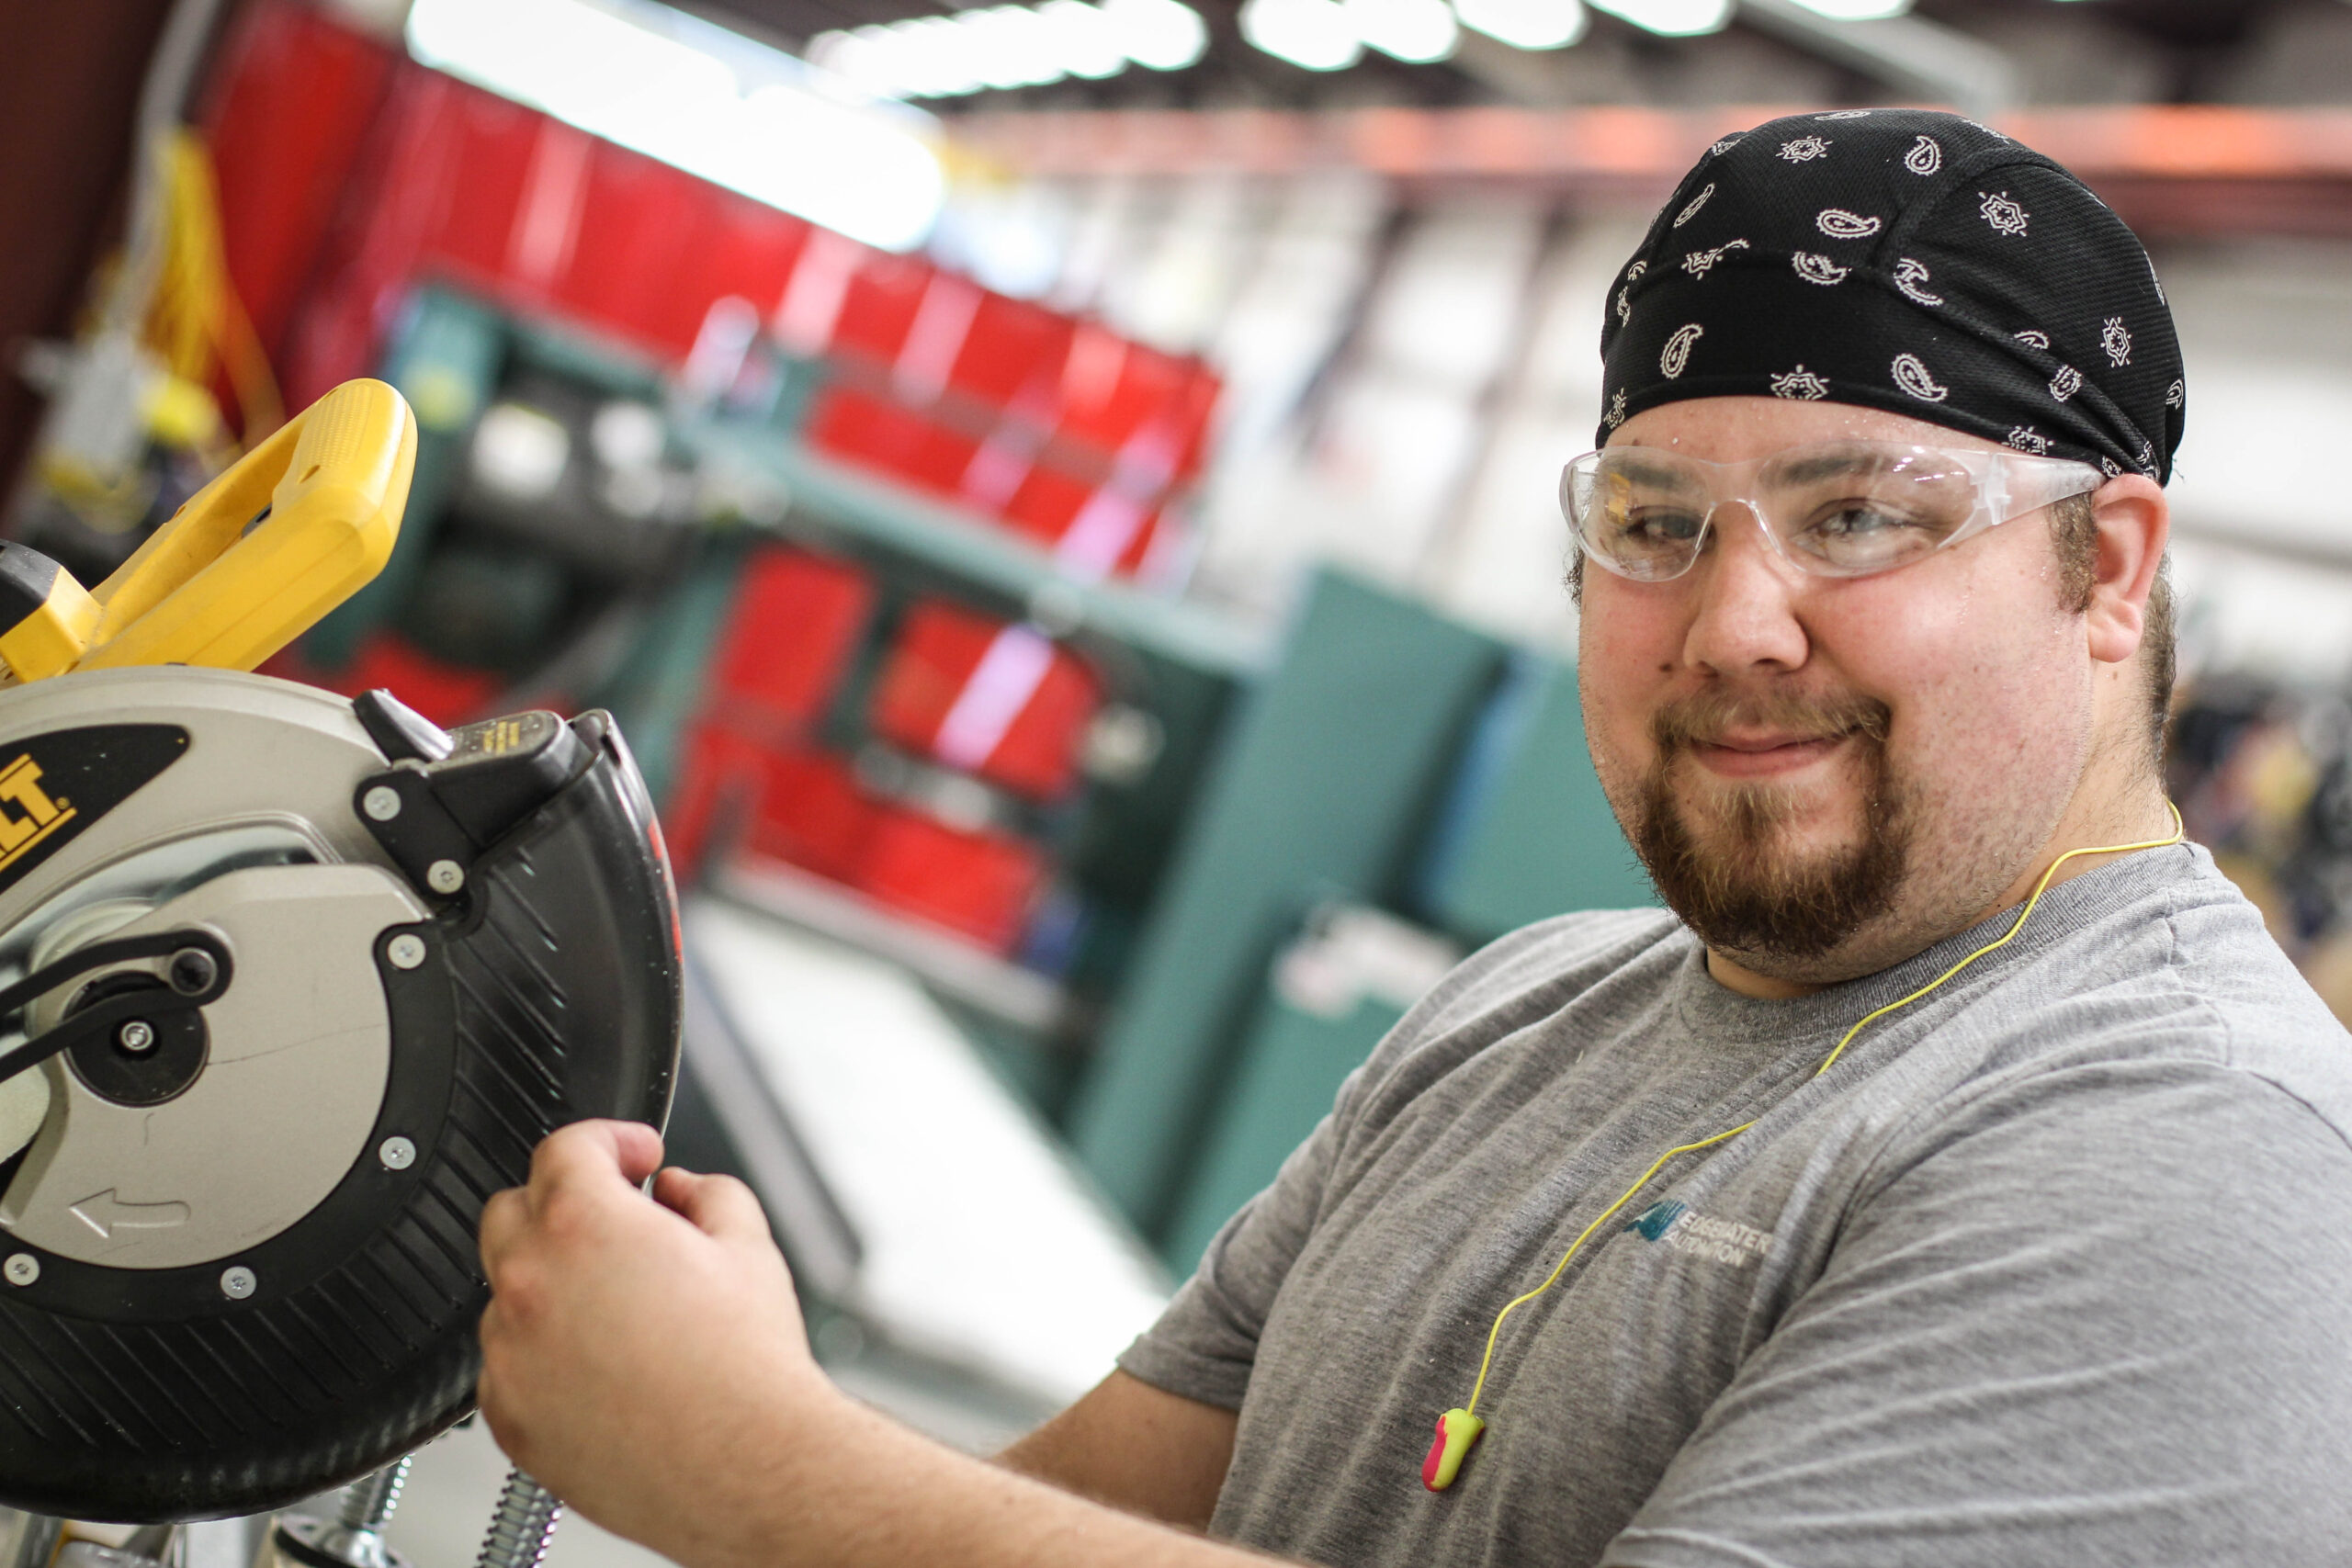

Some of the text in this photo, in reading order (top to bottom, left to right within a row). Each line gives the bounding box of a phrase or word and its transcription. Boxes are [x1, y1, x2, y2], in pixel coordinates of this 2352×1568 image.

[0, 760, 60, 861] LT
[1661, 1230, 1746, 1267] AUTOTION
[1679, 1211, 1773, 1255] EDGEATER
